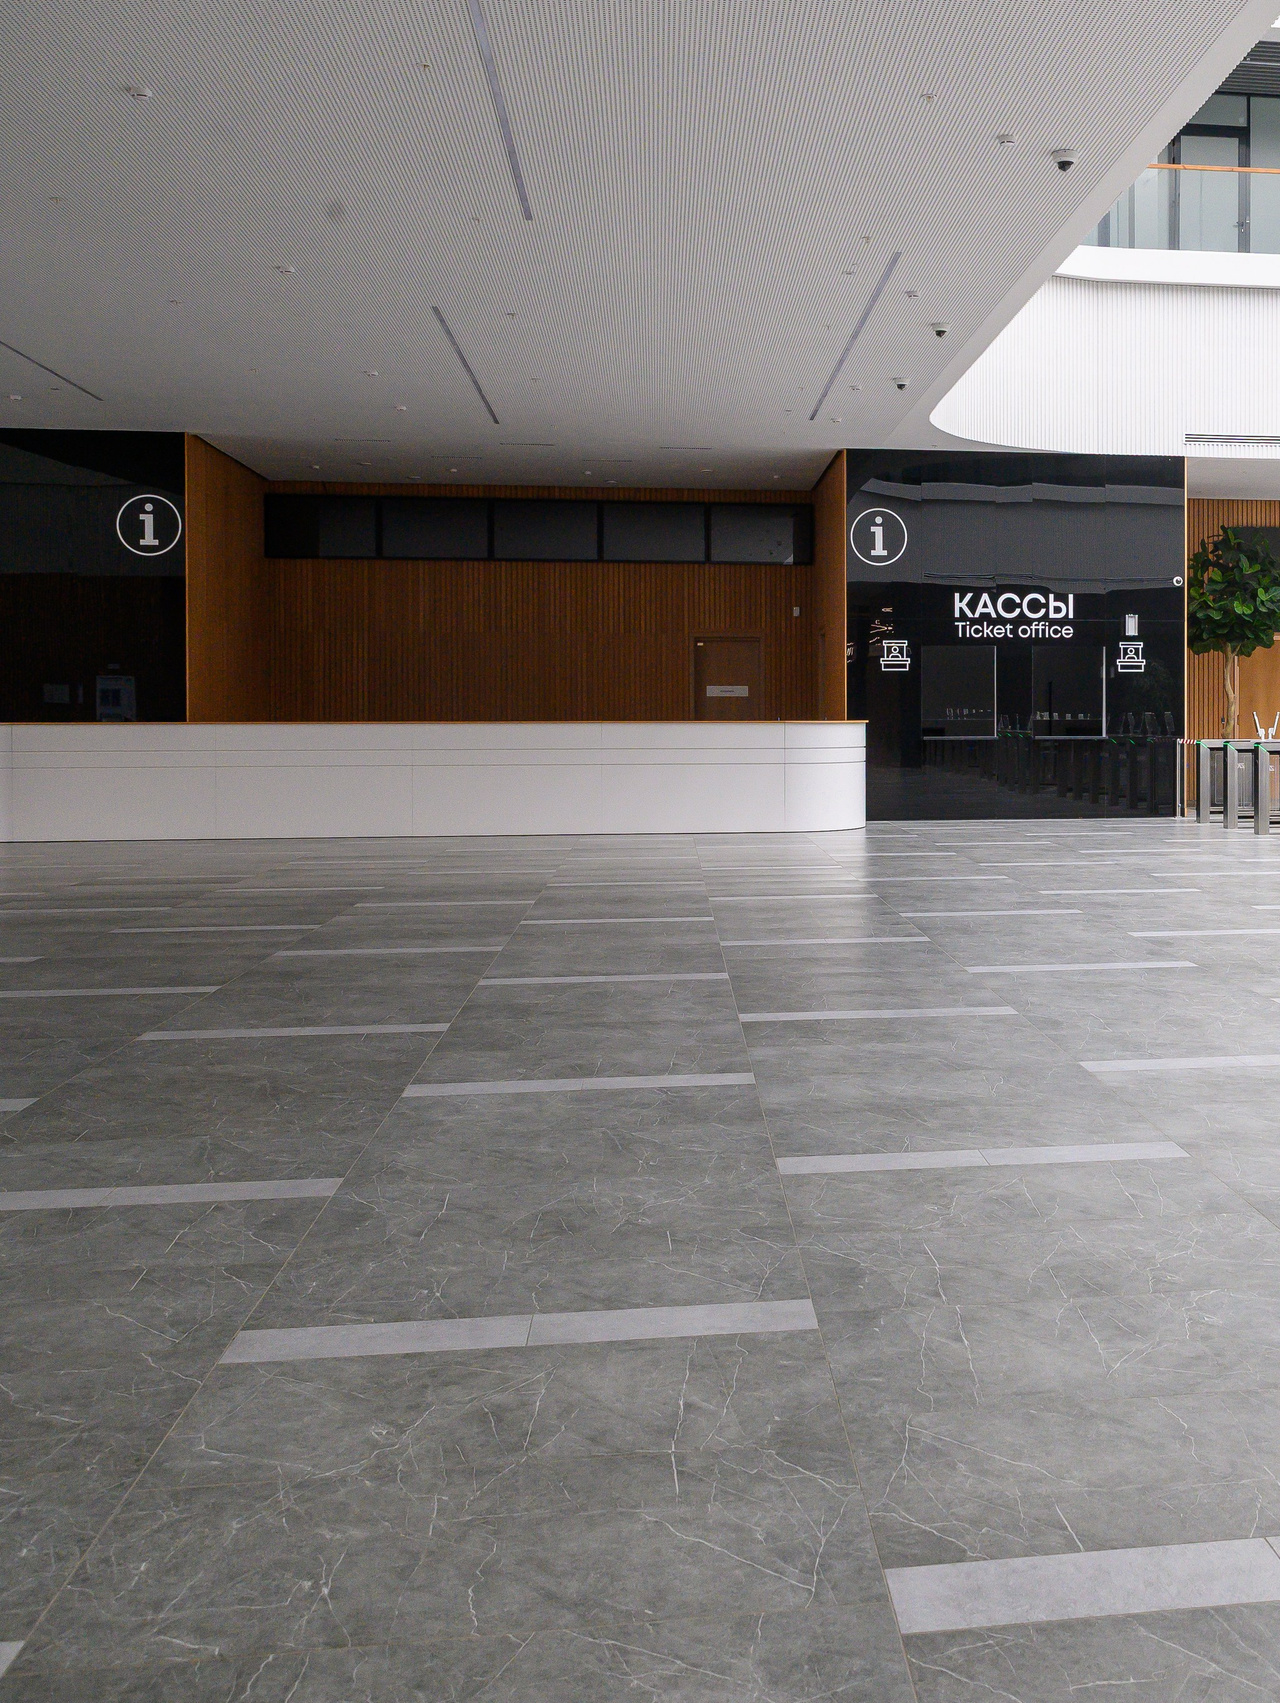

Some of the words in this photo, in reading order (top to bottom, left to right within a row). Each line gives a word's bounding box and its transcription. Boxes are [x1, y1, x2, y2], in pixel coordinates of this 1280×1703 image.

[954, 592, 1074, 619] КАССЫ
[954, 621, 1013, 638] Ticket
[1018, 621, 1074, 638] office
